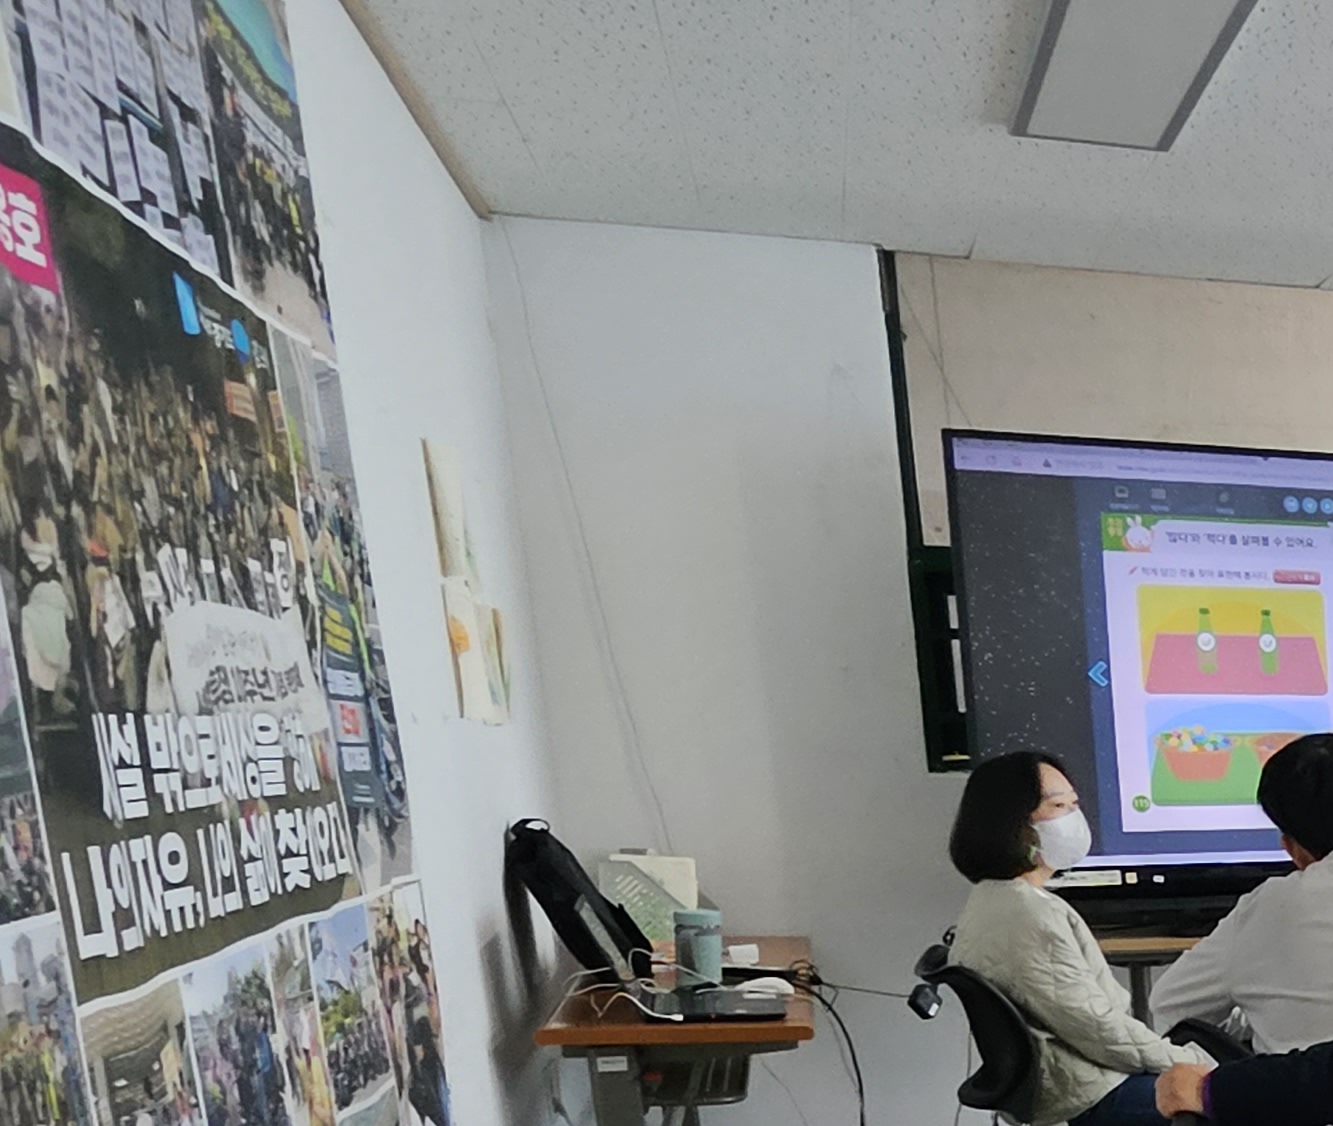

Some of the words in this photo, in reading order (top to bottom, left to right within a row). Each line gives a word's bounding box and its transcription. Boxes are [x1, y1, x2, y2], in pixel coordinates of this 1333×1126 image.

[1274, 536, 1283, 547] 수
[92, 712, 150, 820] 시설
[144, 712, 222, 814] 밖으로
[215, 712, 288, 807] 세상을
